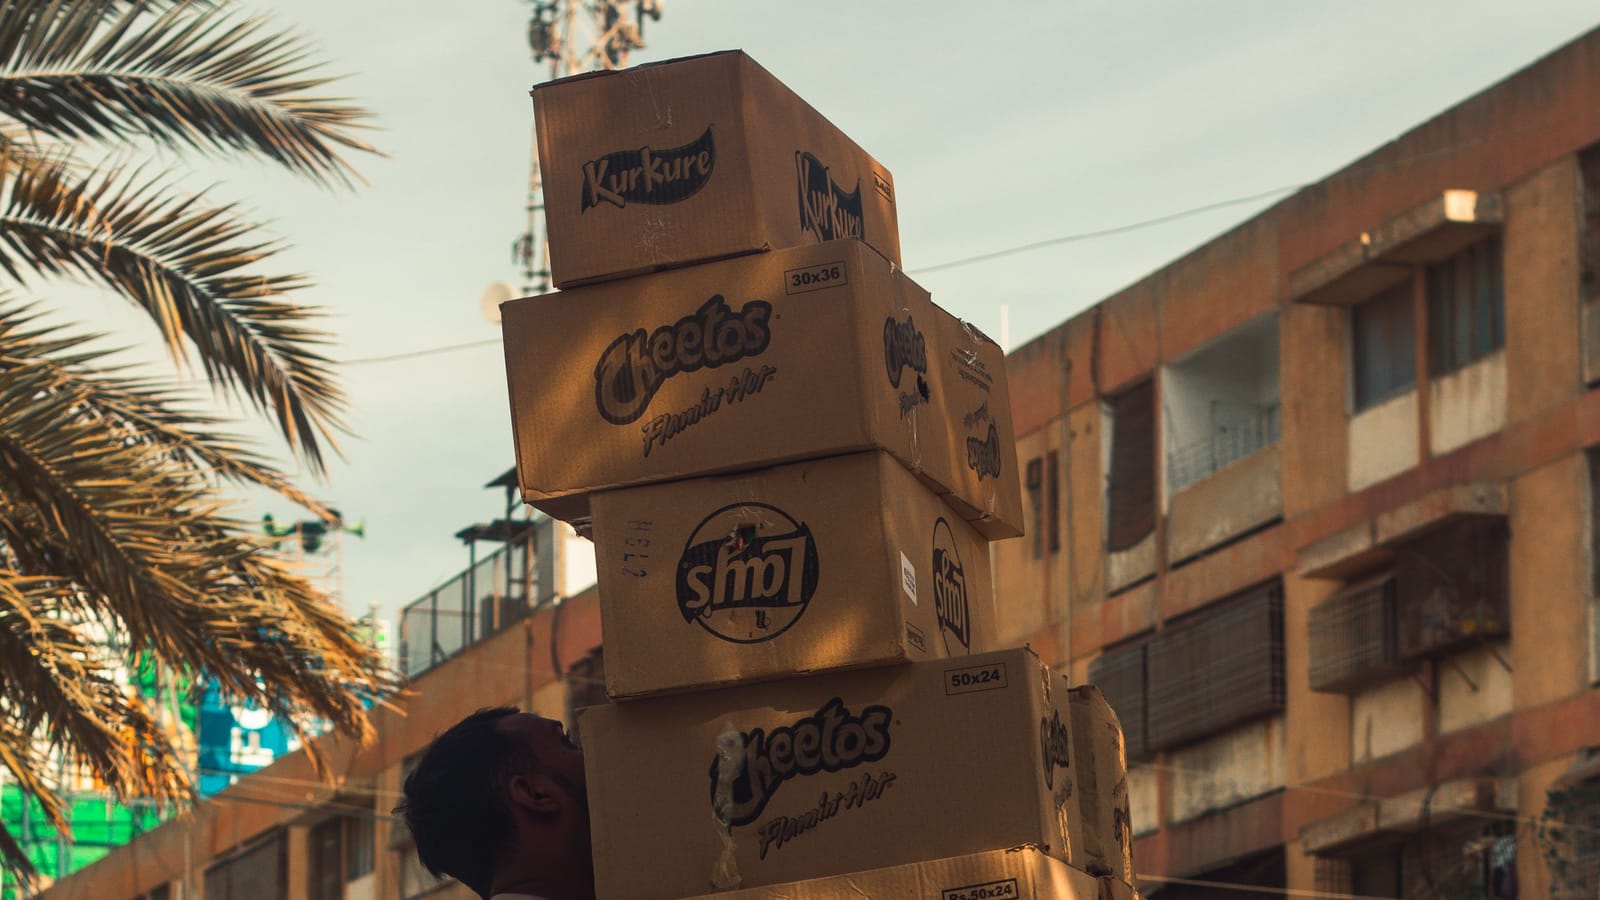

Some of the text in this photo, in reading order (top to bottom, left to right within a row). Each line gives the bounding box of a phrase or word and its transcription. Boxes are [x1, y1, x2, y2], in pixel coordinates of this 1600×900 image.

[582, 146, 711, 208] Kurkure
[792, 267, 840, 286] 30x36
[594, 294, 772, 425] Cheetos
[726, 365, 777, 404] Hot
[685, 535, 807, 619] Lay's
[951, 669, 1001, 687] 50x24
[709, 697, 892, 826] Cheetos
[844, 771, 896, 808] Hot
